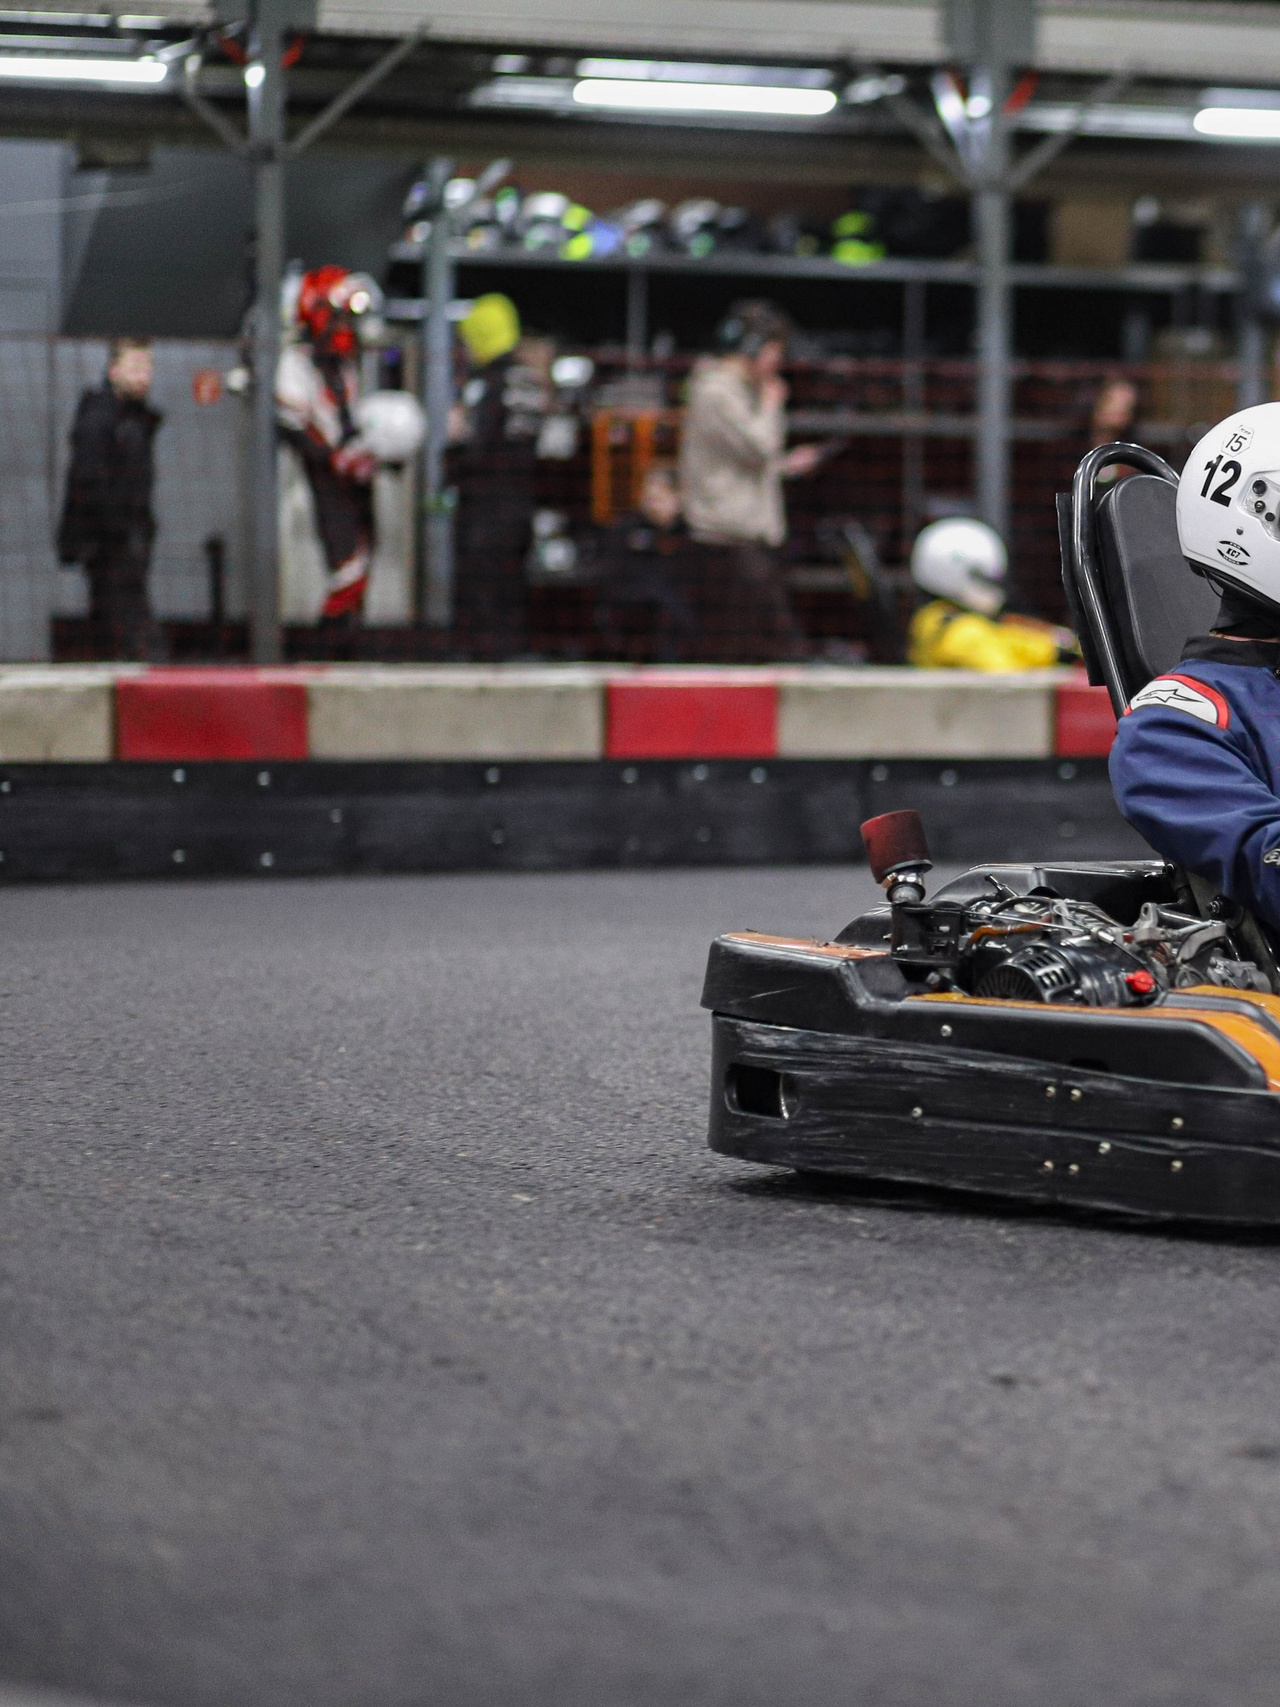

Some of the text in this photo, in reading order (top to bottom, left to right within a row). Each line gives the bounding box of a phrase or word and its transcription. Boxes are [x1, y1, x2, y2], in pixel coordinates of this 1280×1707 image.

[1225, 433, 1247, 452] 15
[1200, 454, 1242, 507] 12
[1226, 547, 1241, 558] KC7
